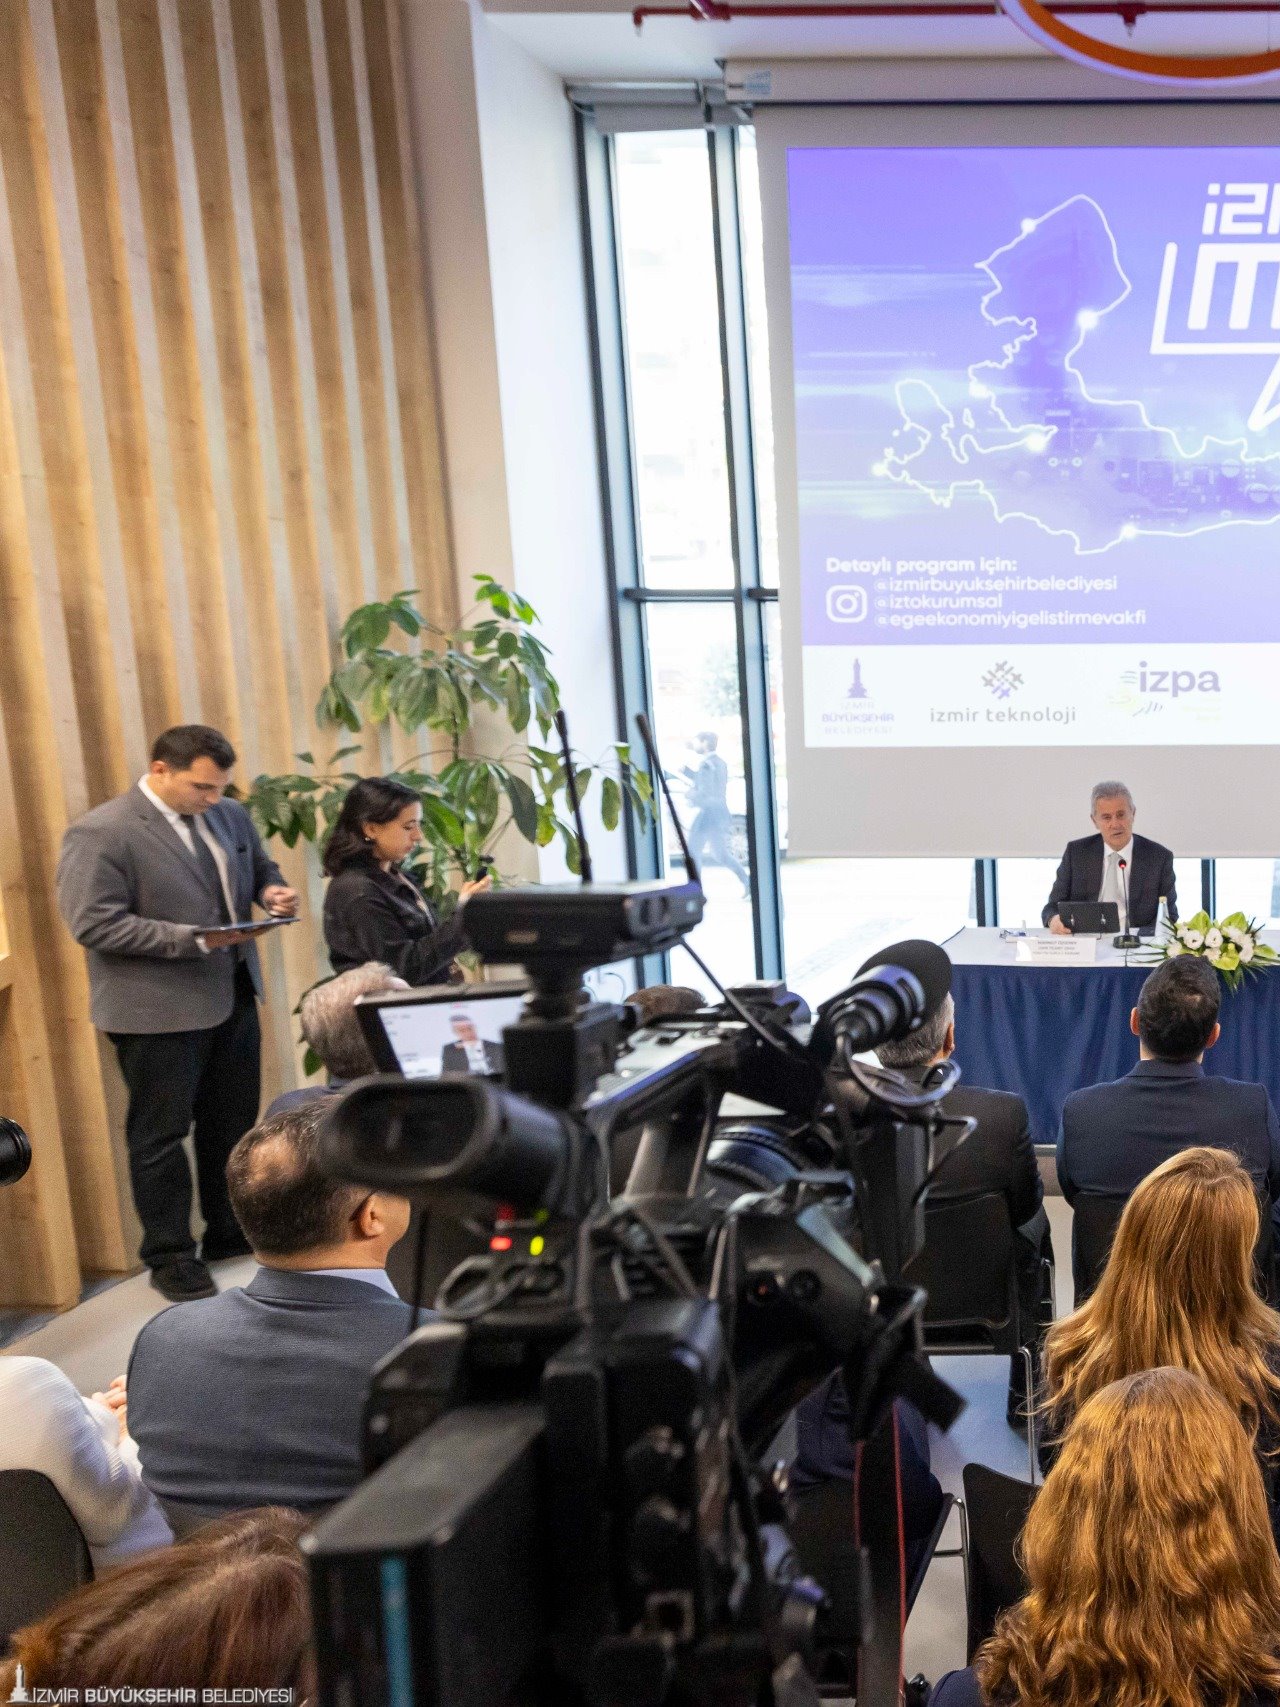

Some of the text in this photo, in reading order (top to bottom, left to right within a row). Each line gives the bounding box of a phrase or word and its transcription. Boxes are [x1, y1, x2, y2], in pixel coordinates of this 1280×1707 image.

[826, 557, 892, 575] Detaylı
[896, 559, 976, 576] program
[874, 576, 1118, 593] @izmirbuyuksehirbelediyesi
[874, 594, 1003, 609] @iztokurumsal
[874, 610, 1147, 630] @egeekonomiyigelistirmevakfi
[1138, 660, 1222, 698] izpa
[930, 706, 1077, 725] izmir teknoloji
